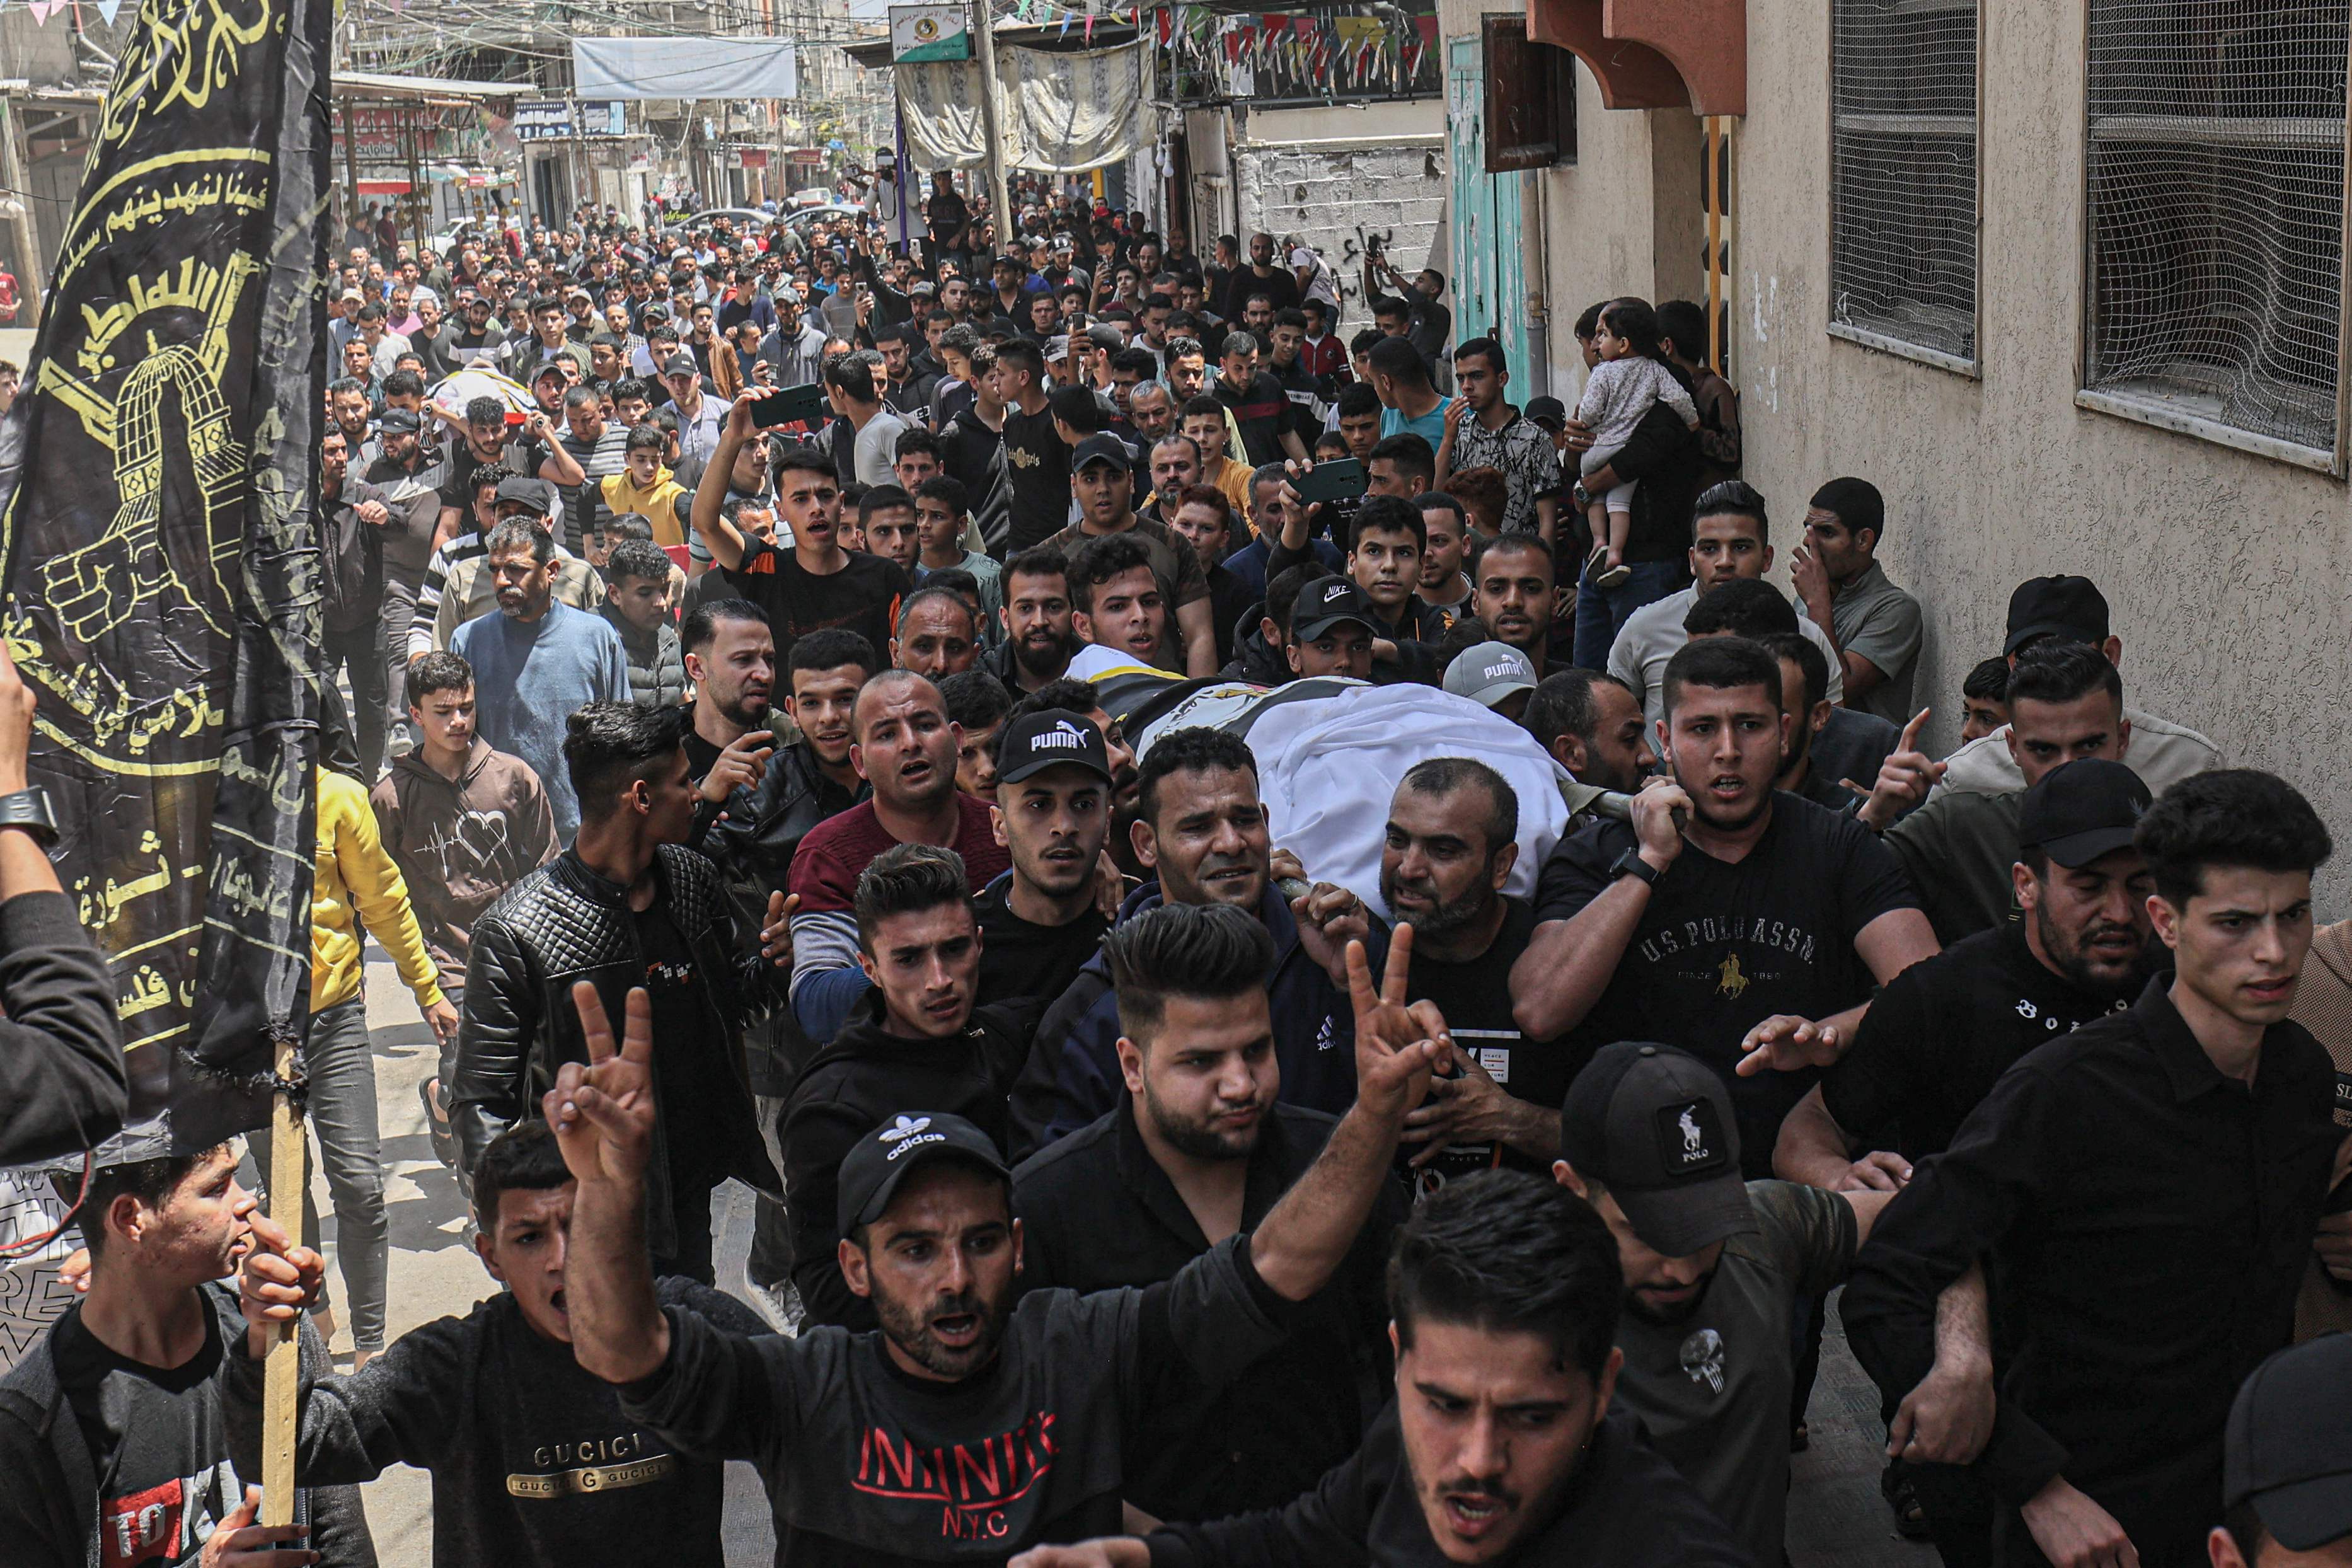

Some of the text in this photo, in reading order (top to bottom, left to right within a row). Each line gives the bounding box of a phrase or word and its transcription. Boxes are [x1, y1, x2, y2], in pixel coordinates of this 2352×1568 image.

[146, 255, 220, 313] الله
[1327, 585, 1347, 596] NIKE
[1484, 662, 1520, 679] PUMA
[1031, 732, 1078, 752] PUMA
[79, 829, 171, 930] ثورة
[1684, 915, 1746, 946] POLO
[887, 1134, 945, 1161] adidas
[1683, 1148, 1709, 1162] POLO
[534, 1432, 641, 1468] GUCICI
[608, 1465, 662, 1482] GUCICI
